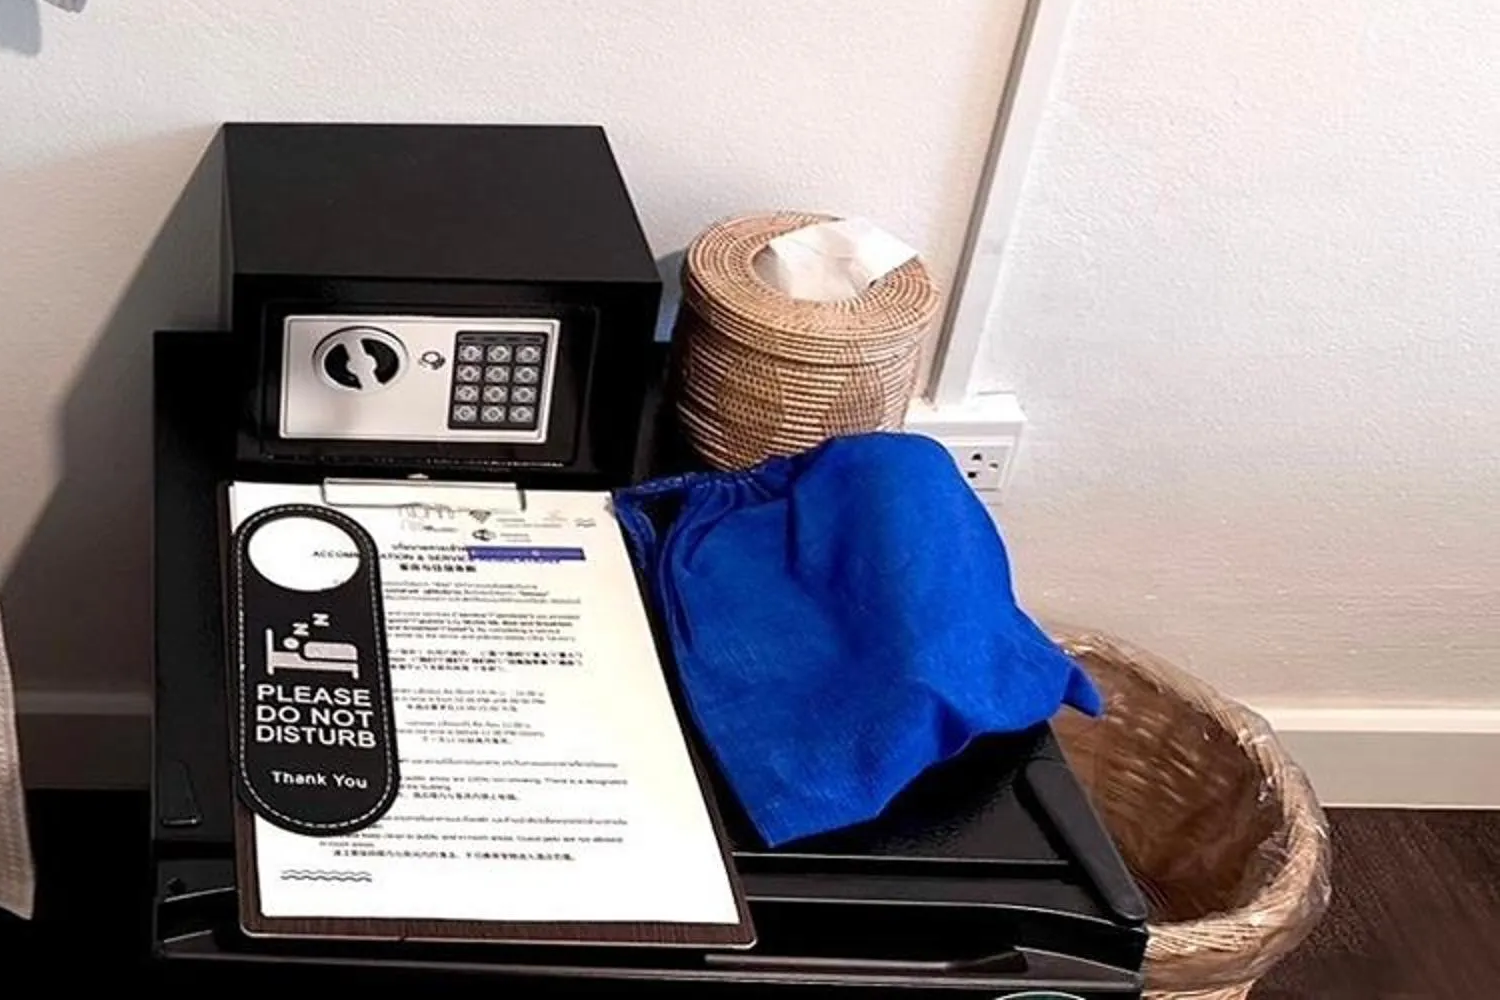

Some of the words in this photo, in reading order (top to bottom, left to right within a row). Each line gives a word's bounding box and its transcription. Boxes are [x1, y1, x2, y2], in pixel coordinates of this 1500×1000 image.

[256, 683, 372, 707] PLEASE
[256, 705, 300, 723] DO
[310, 707, 374, 728] NOT
[256, 725, 377, 748] DISTURB
[272, 770, 327, 786] Thank
[333, 774, 368, 789] You
